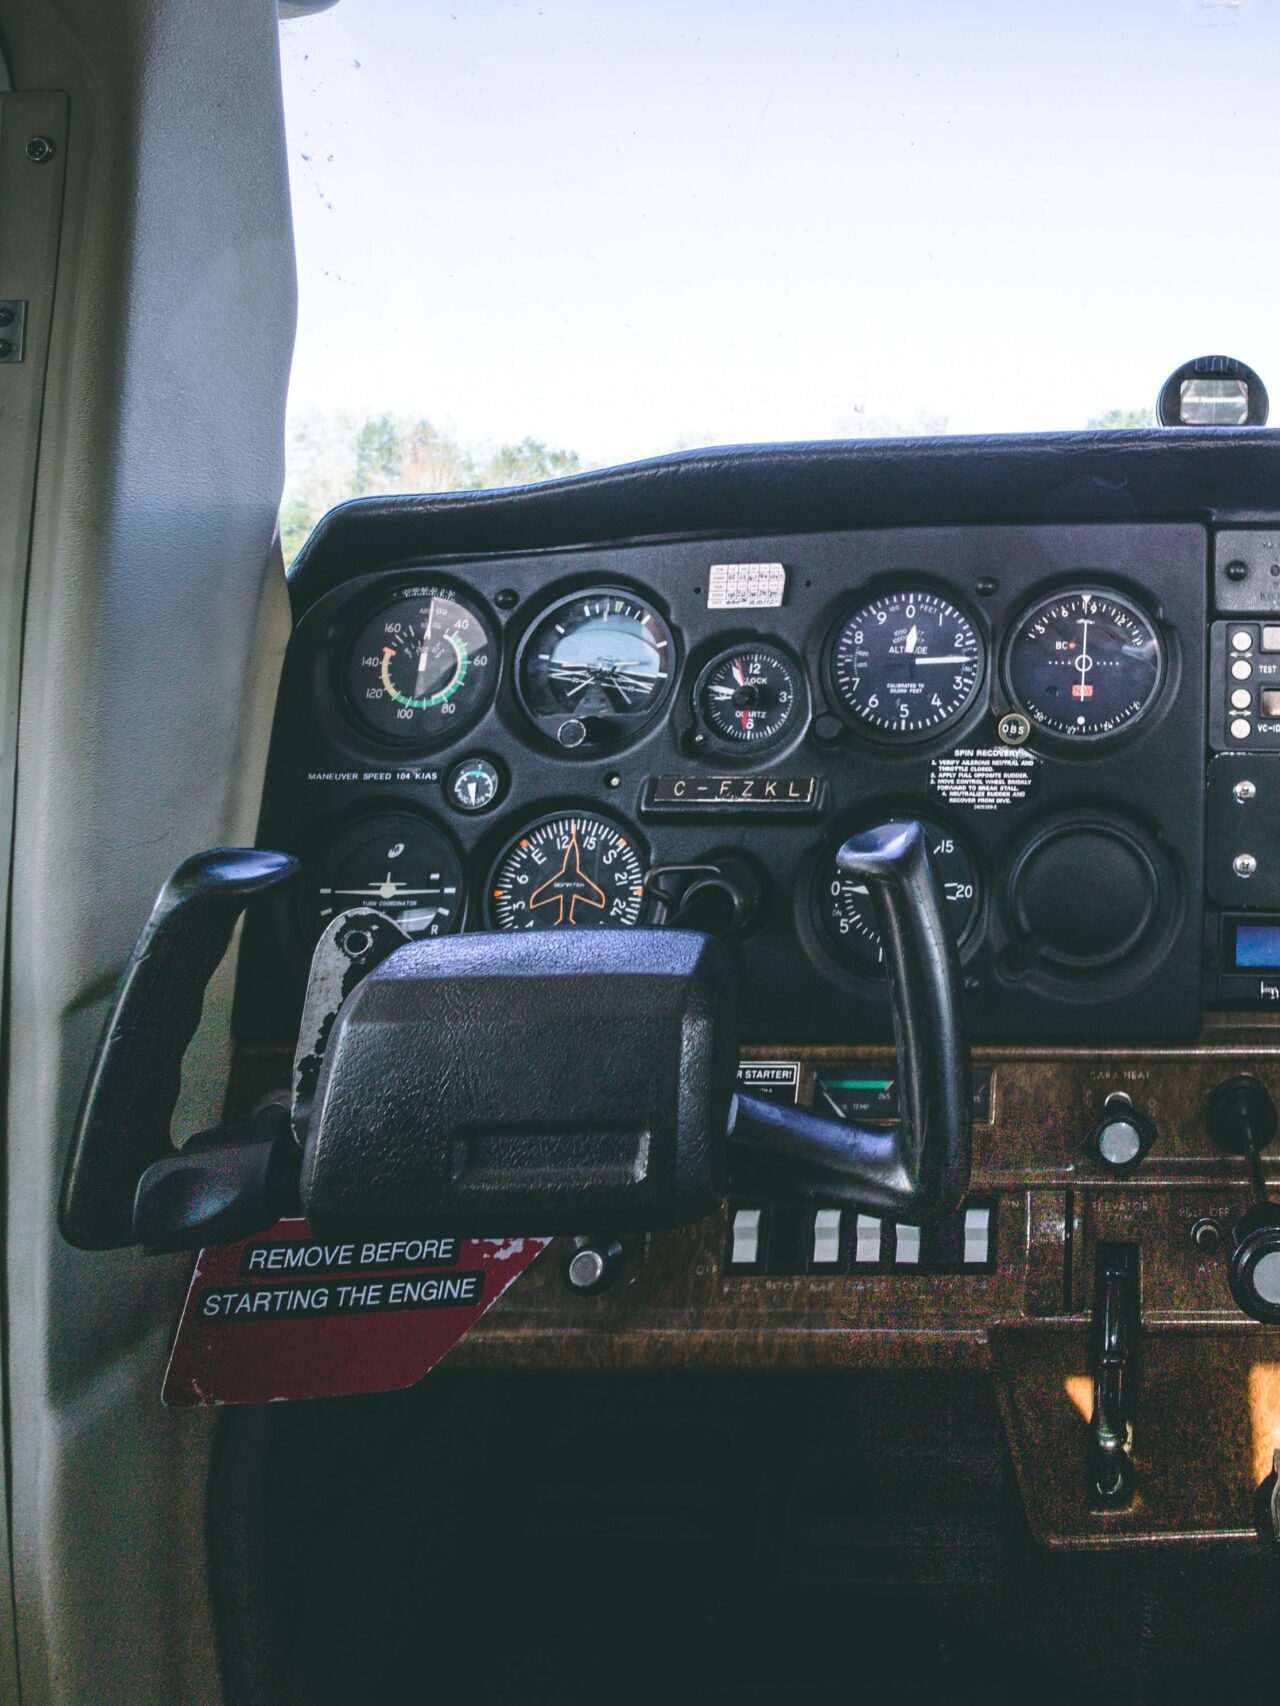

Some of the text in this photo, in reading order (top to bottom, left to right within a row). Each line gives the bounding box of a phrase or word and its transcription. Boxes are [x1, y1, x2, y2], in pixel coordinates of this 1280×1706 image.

[876, 611, 887, 625] 9
[905, 604, 916, 619] 0
[384, 622, 402, 633] 160
[455, 620, 469, 629] 40
[854, 630, 864, 644] 8
[954, 633, 964, 648] 2
[1055, 642, 1068, 650] BC
[362, 657, 380, 668] 140
[473, 656, 488, 667] 60
[749, 663, 761, 675] 12
[1258, 665, 1277, 674] TEST
[851, 677, 860, 692] 7
[952, 676, 963, 690] 3
[365, 688, 383, 699] 120
[779, 691, 788, 703] 3
[931, 693, 941, 707] 4
[868, 694, 879, 708] 6
[396, 708, 414, 719] 100
[441, 703, 456, 714] 80
[899, 704, 909, 718] 5
[745, 718, 754, 730] 6
[1002, 724, 1025, 735] OBS
[954, 749, 1020, 758] SPIN RECOVERY
[308, 772, 437, 781] MANEUVER SPEED 104 KIAS
[556, 835, 571, 850] 12
[582, 835, 598, 851] 15
[940, 839, 954, 854] 15
[530, 847, 548, 866] E
[602, 849, 618, 865] S
[516, 873, 529, 885] 6
[614, 871, 629, 886] 21
[830, 881, 841, 896] 0
[955, 884, 973, 899] 20
[609, 898, 627, 917] 24
[430, 924, 439, 935] R
[839, 918, 849, 934] 5
[744, 1069, 792, 1079] STARTER!
[248, 1238, 455, 1271] REMOVE BEFORE
[203, 1276, 477, 1317] STARTING THE ENGINE
